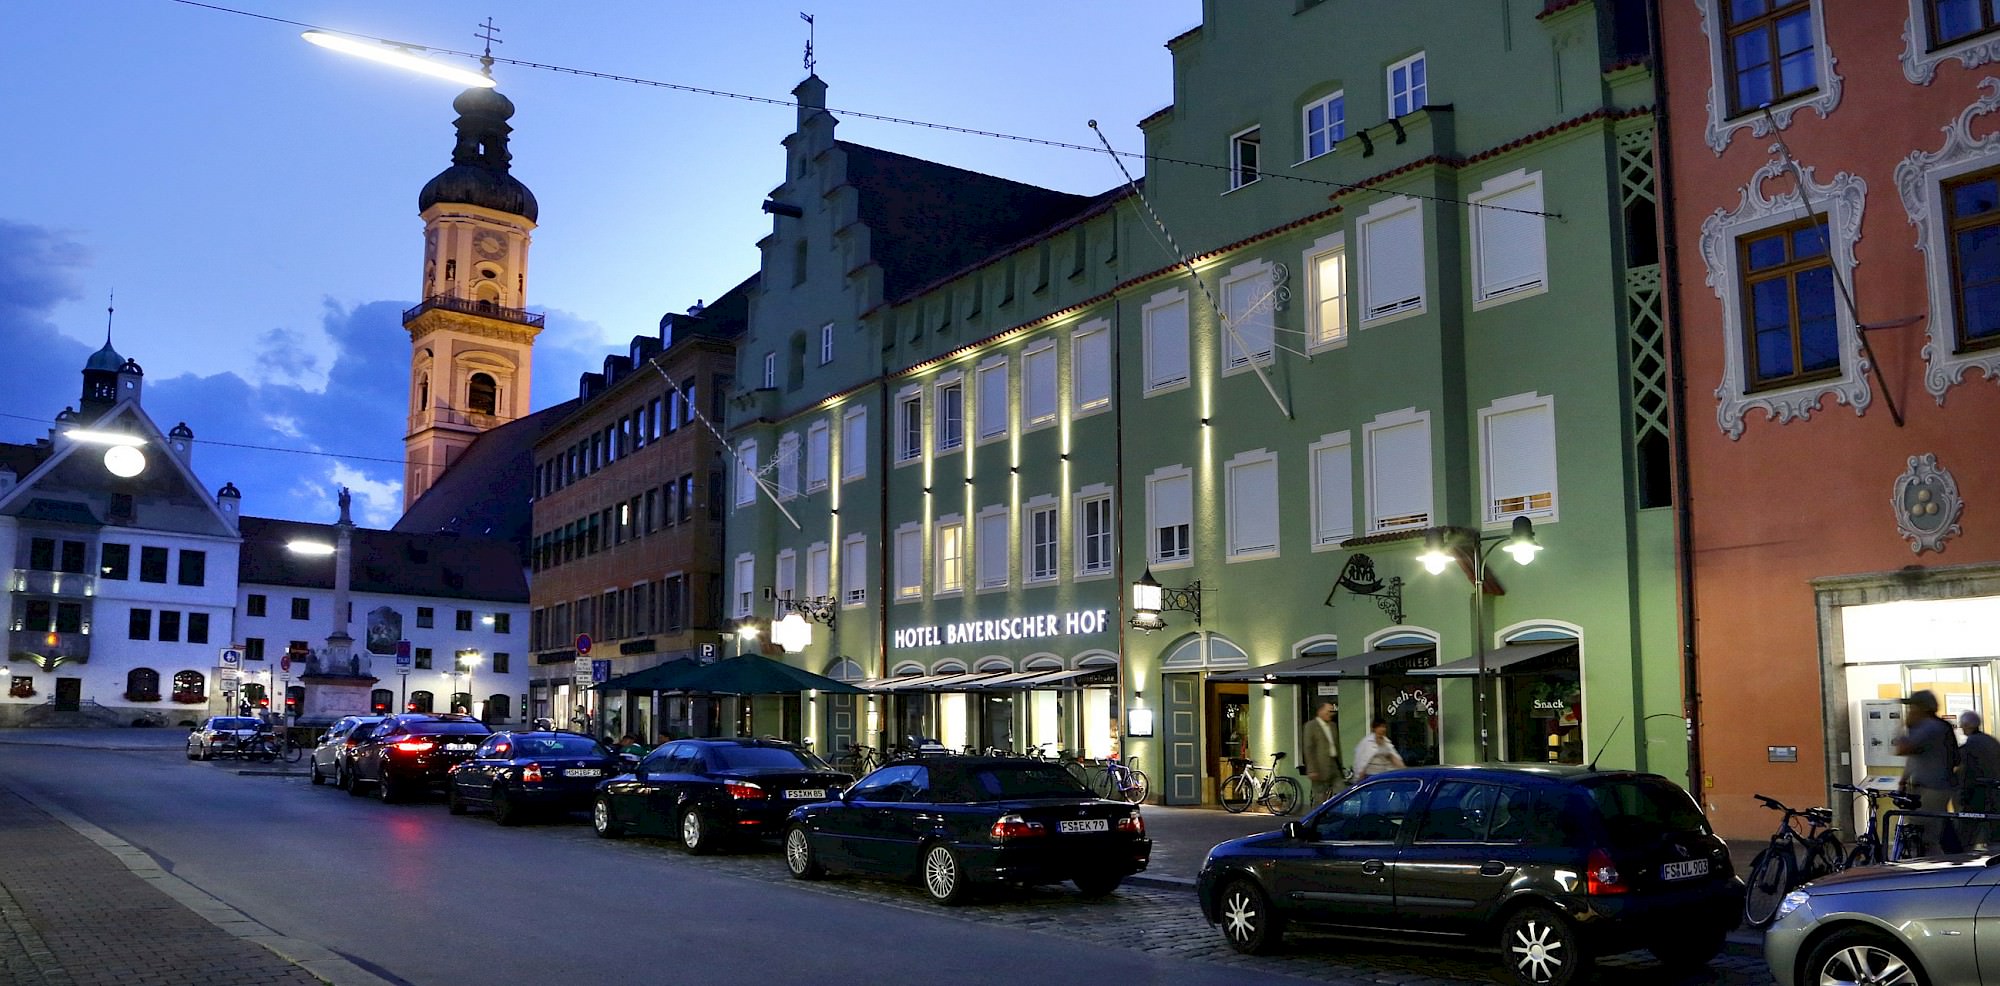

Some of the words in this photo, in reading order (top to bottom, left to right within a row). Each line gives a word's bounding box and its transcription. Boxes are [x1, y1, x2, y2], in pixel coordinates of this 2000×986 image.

[894, 625, 942, 649] HOTEL
[947, 614, 1058, 644] BAYERISCHER
[1066, 609, 1108, 635] HOF
[1534, 699, 1564, 709] Snack
[788, 790, 798, 798] FS
[1061, 821, 1074, 831] FS
[1079, 821, 1091, 831] EK
[1093, 820, 1105, 830] 79
[1665, 864, 1676, 879] FS
[1681, 862, 1693, 876] UL
[1693, 860, 1708, 874] 903
